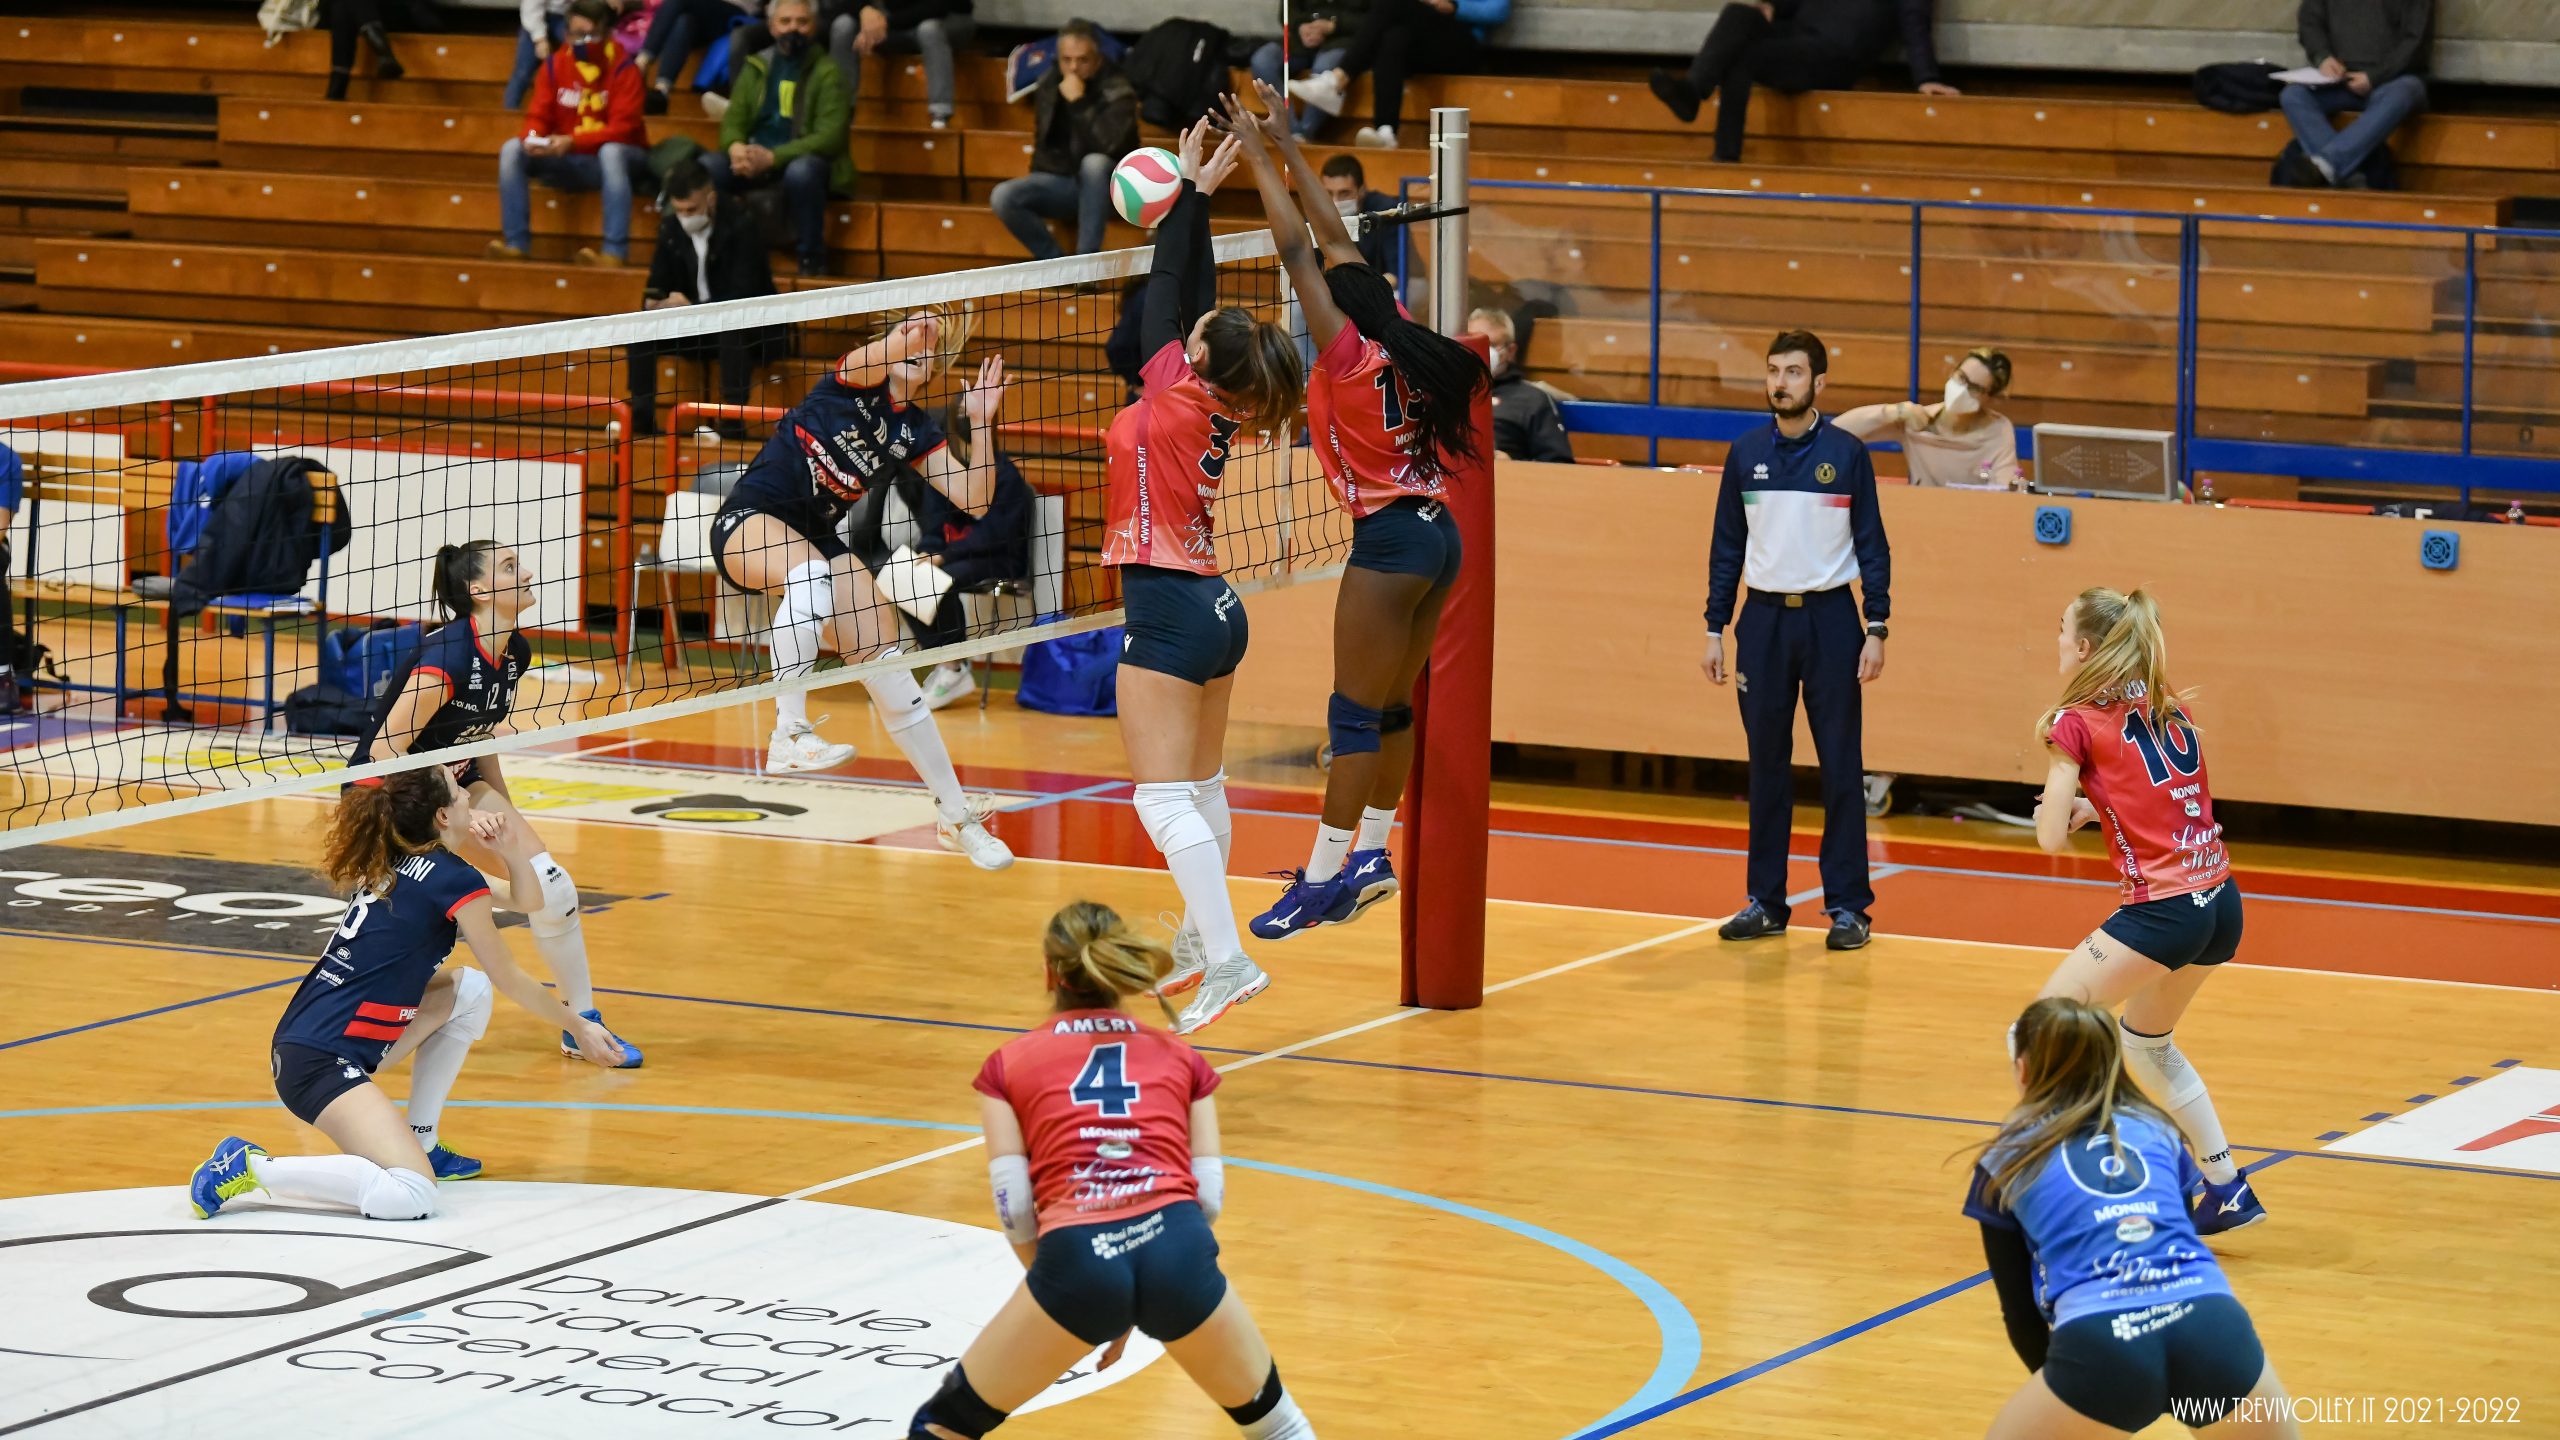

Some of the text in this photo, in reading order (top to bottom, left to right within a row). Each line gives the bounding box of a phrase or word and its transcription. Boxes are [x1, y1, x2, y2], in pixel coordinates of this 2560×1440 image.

[1198, 412, 1242, 480] 3
[1137, 445, 1150, 546] WWW.TREVIVOLLEY.IT
[2121, 707, 2201, 787] 10
[2169, 783, 2201, 801] MONINI
[1053, 1018, 1138, 1035] AMERI
[1069, 1041, 1140, 1118] 4
[1079, 1126, 1141, 1139] MONINI
[2093, 1201, 2159, 1224] MONINI
[520, 1274, 932, 1332] Daniele
[2100, 1275, 2204, 1299] energia pulita
[2149, 1306, 2184, 1331] Servizi
[369, 1323, 824, 1388] General
[285, 1348, 894, 1431] Contractor
